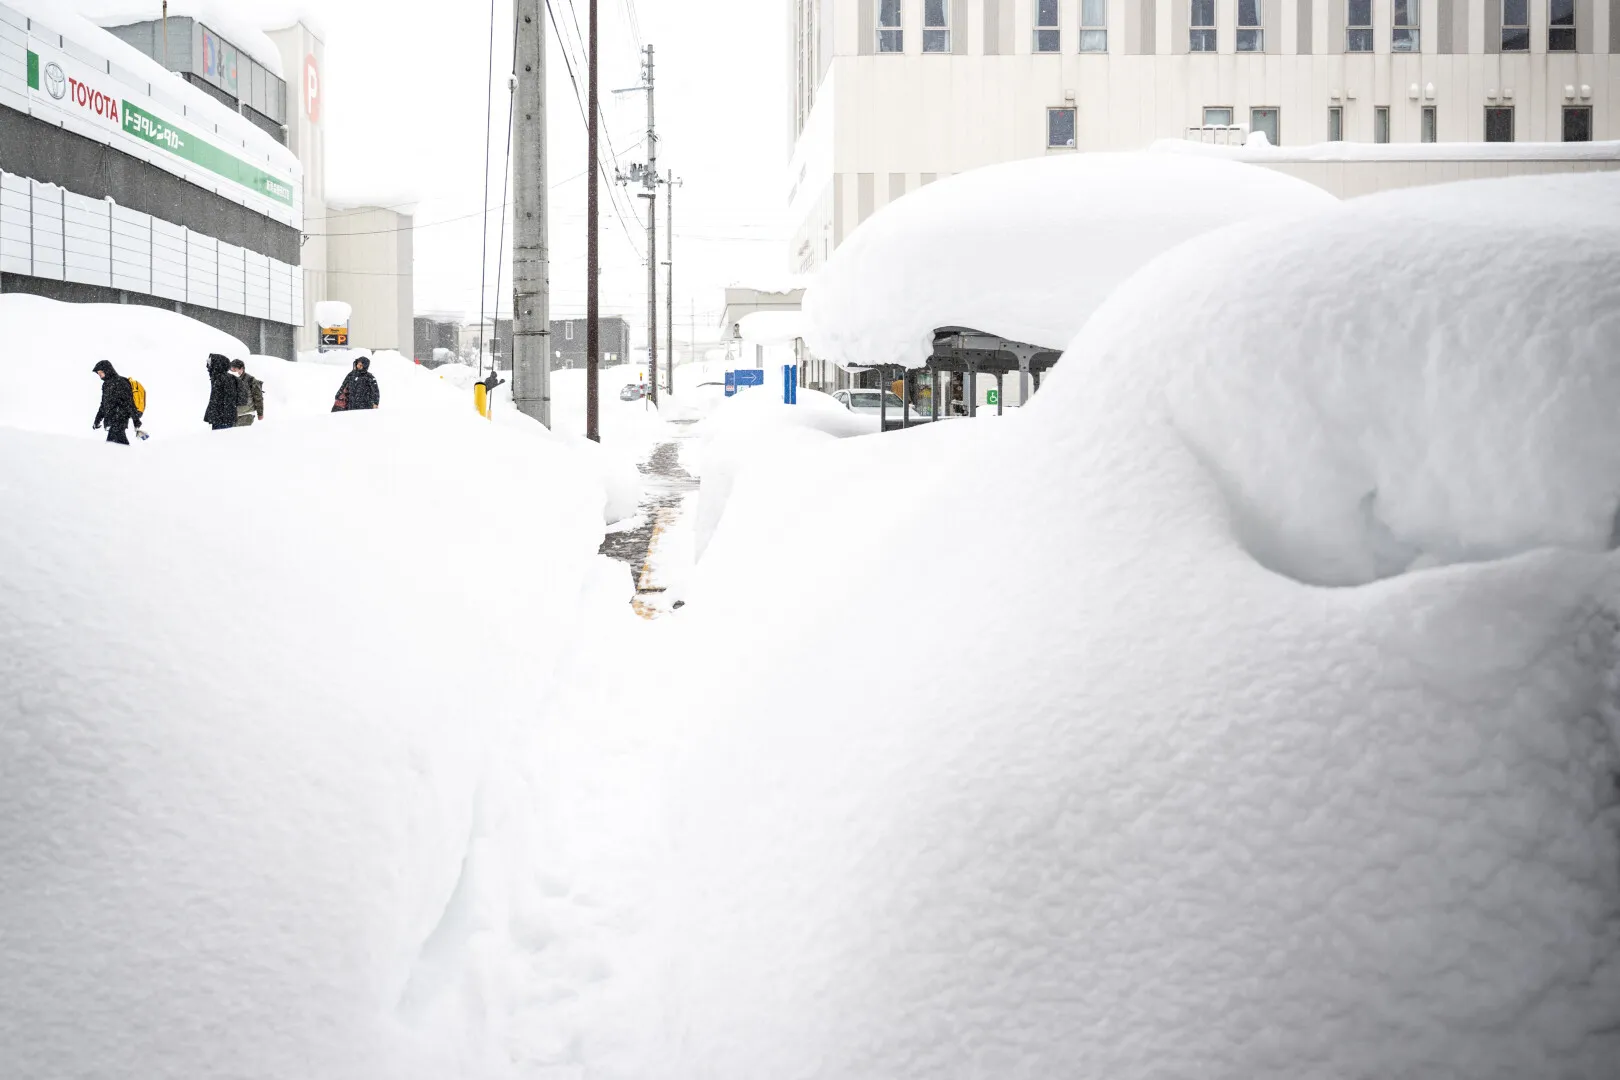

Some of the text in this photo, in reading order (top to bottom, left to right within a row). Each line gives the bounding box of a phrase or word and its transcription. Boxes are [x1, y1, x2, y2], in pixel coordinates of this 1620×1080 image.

[68, 77, 119, 123] TOYOTA
[307, 63, 318, 114] P
[125, 108, 185, 149] トヨタレンタカー
[337, 334, 347, 345] P
